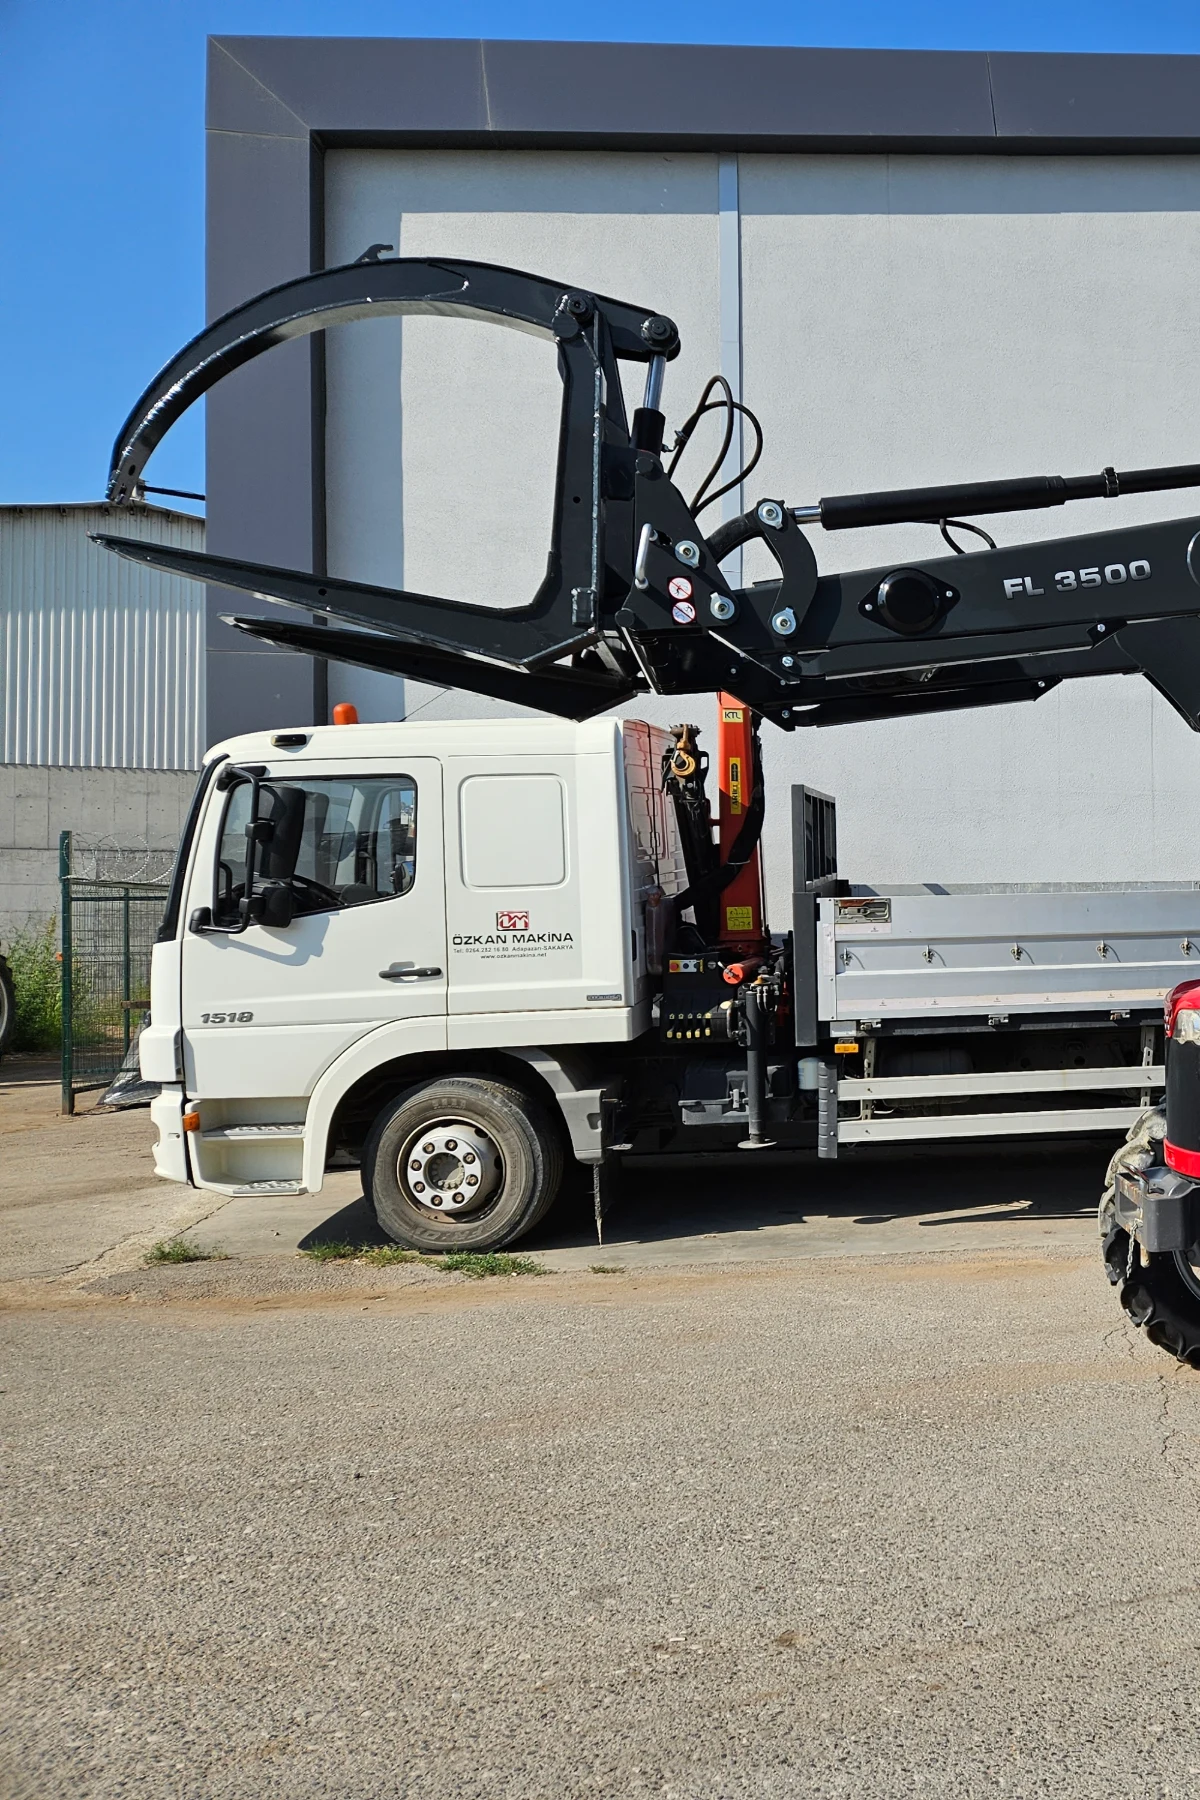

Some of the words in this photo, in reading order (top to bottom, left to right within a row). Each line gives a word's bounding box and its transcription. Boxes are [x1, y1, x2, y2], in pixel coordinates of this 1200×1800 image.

[1003, 576, 1045, 600] FL
[1054, 559, 1151, 592] 3500
[725, 711, 741, 719] KTL
[452, 933, 507, 946] ÖZKAN
[512, 931, 574, 944] MAKİNA
[200, 1011, 254, 1024] 1518
